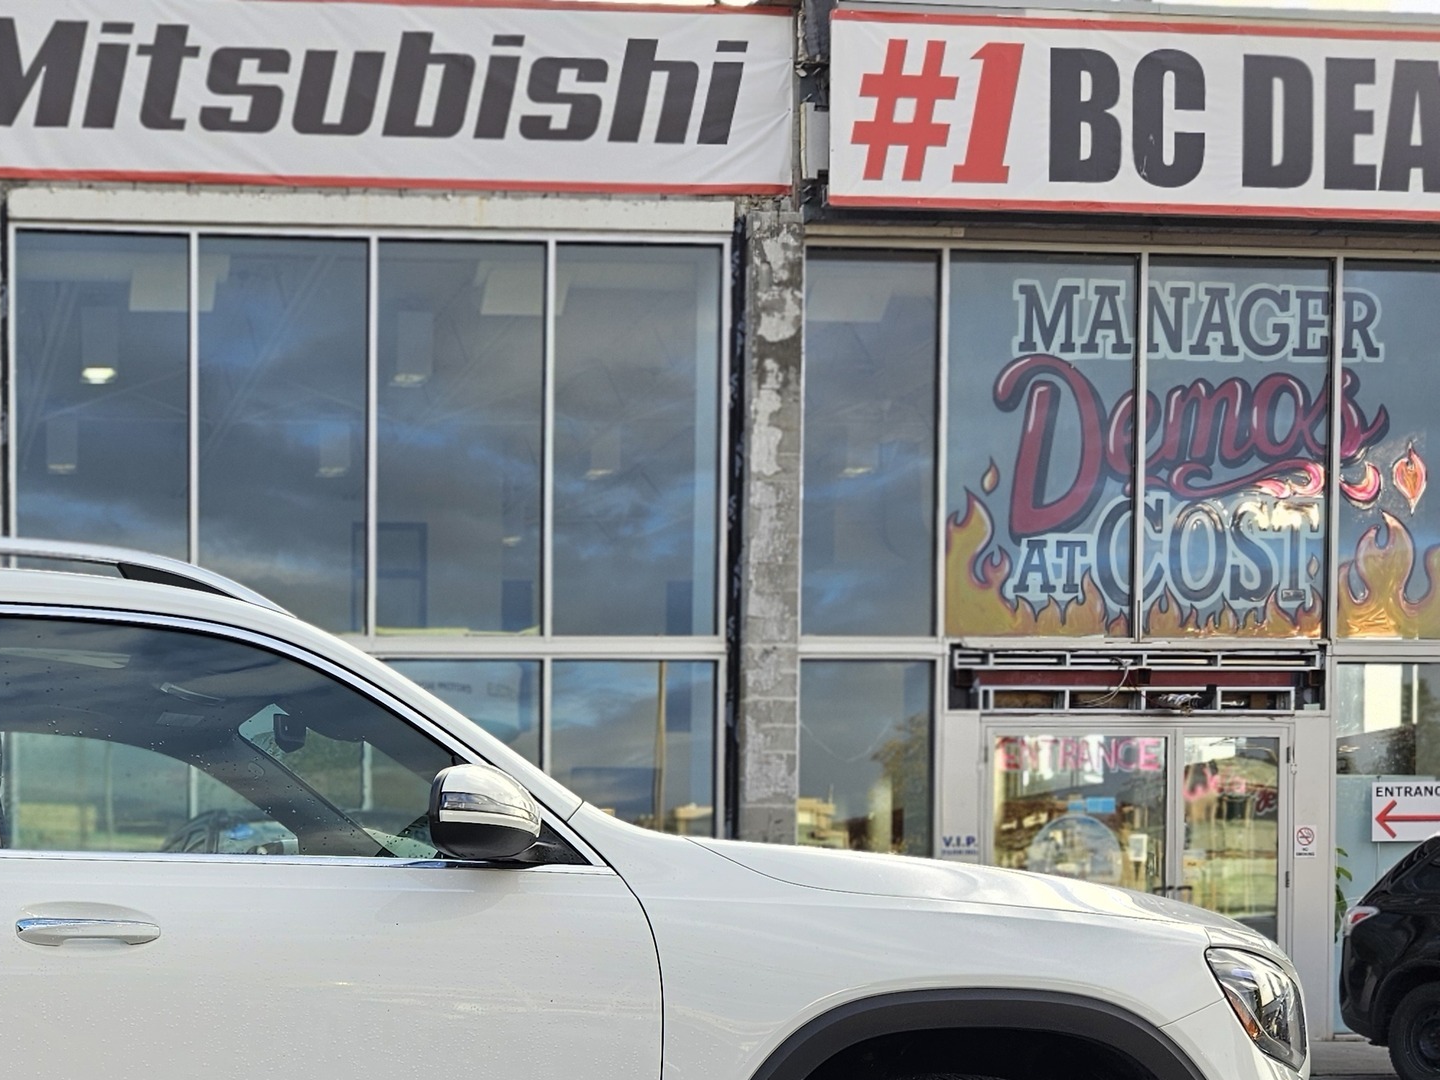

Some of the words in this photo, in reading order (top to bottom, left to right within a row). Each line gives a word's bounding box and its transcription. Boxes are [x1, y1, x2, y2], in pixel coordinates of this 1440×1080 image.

[850, 38, 1025, 184] #1
[1048, 46, 1206, 188] BC
[1012, 279, 1384, 363] MANAGER
[992, 353, 1390, 540] Demos
[1008, 537, 1088, 600] AT
[1095, 495, 1325, 606] COST
[996, 735, 1162, 774] ENTRANCE
